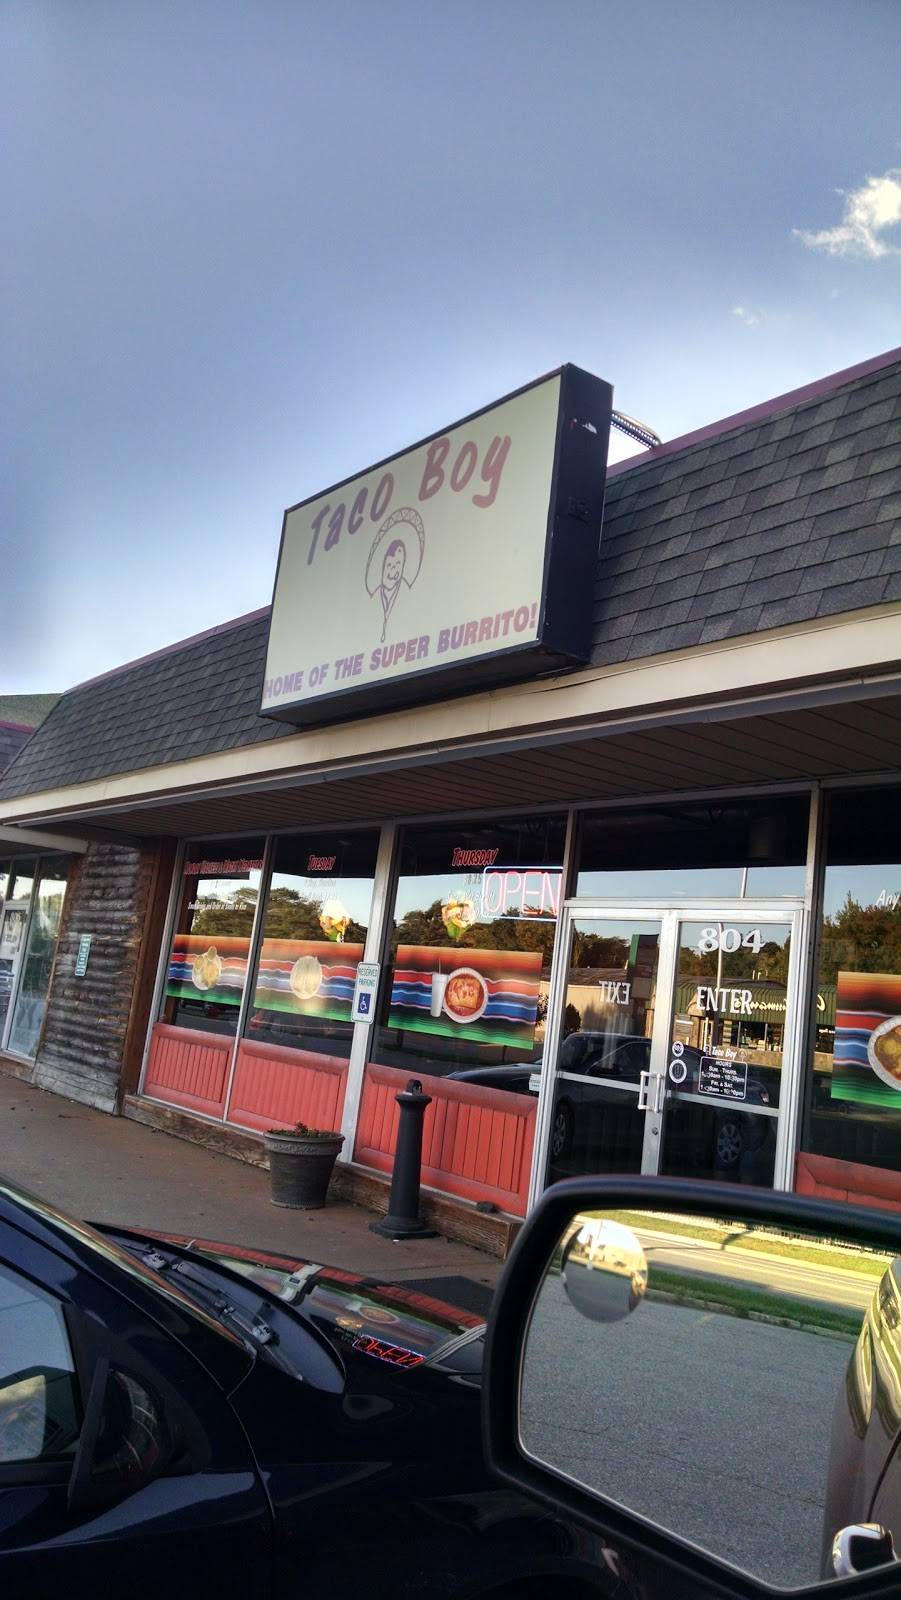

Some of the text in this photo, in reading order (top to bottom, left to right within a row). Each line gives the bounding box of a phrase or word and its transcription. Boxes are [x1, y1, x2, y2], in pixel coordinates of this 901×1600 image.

[264, 602, 538, 700] HOME OF THE SUPER BURRITO!
[307, 855, 336, 871] TUESDAY
[452, 848, 499, 866] THURSDAY
[485, 871, 563, 916] OPEN
[698, 928, 765, 954] 804
[696, 986, 753, 1015] ENTER
